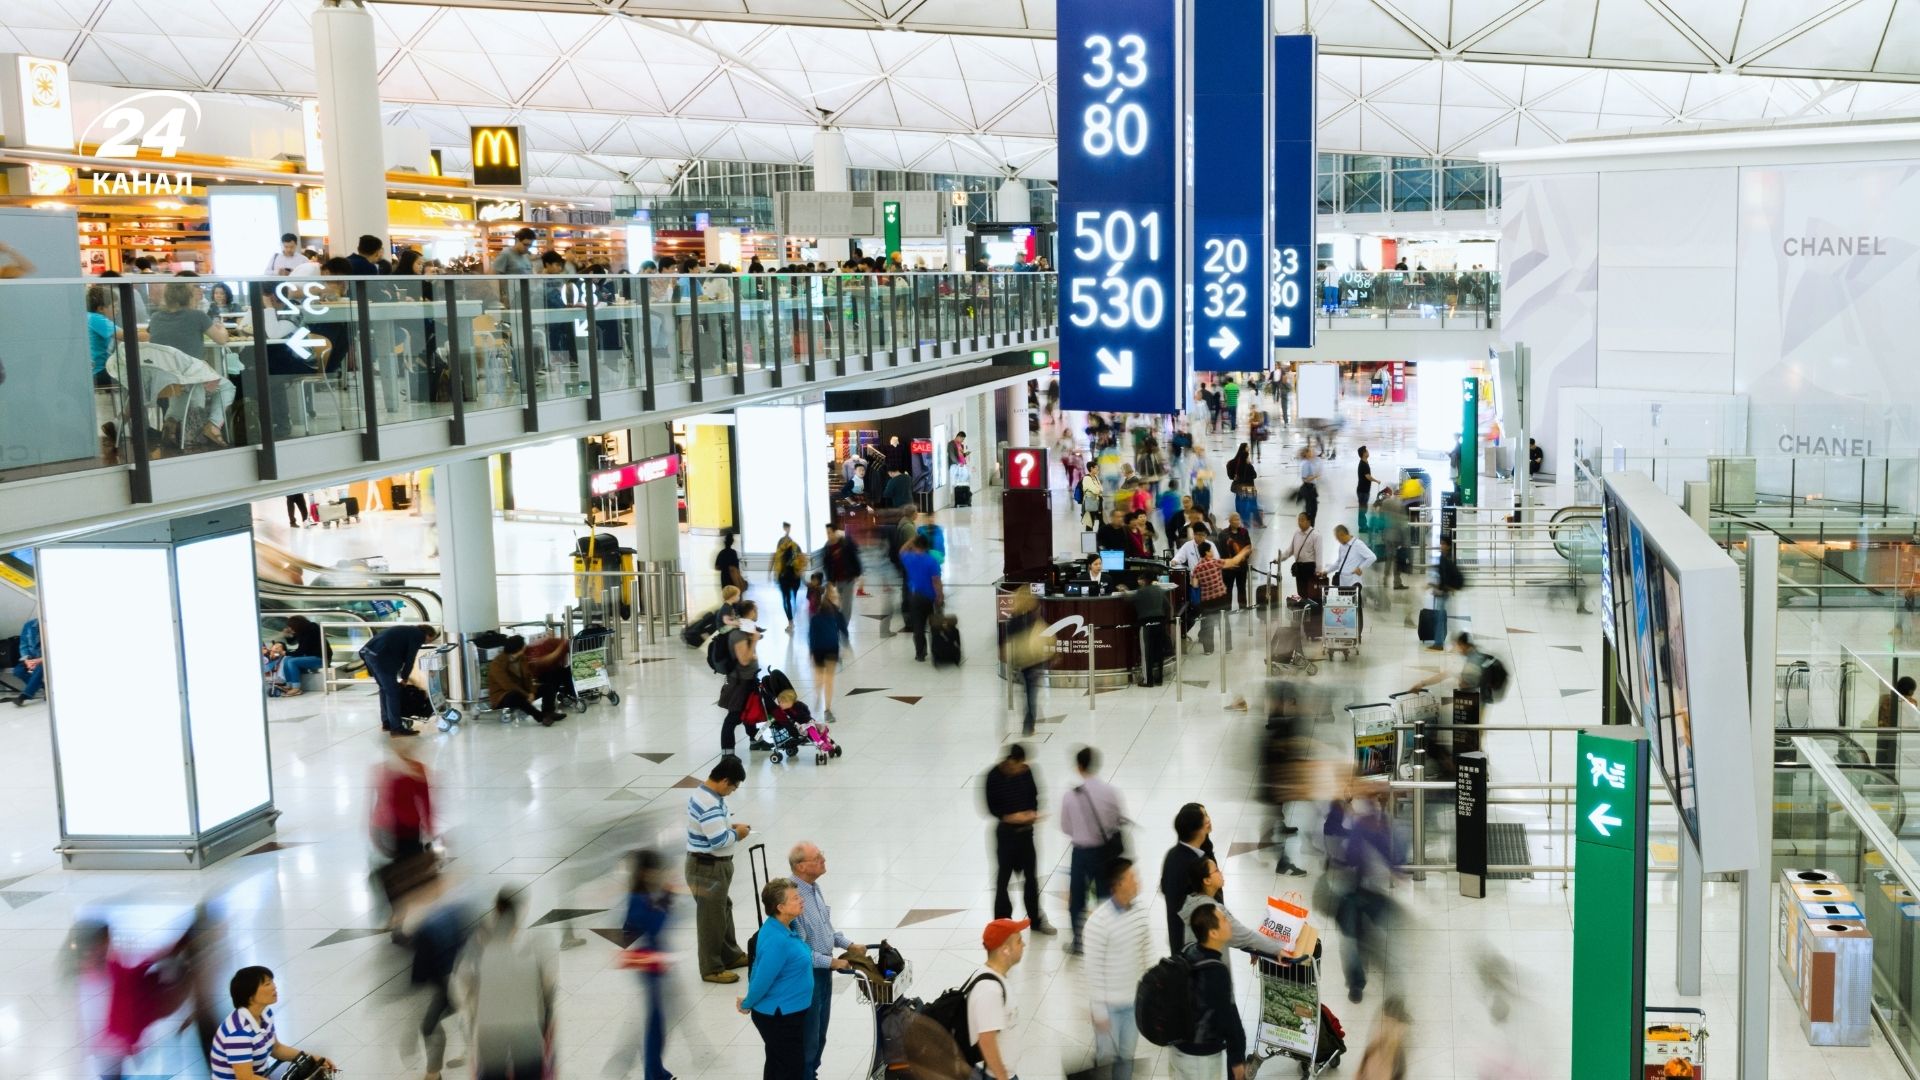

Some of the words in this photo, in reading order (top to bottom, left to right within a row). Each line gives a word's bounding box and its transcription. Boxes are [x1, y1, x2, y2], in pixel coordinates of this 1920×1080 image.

[1083, 35, 1148, 88] 33
[1083, 103, 1148, 156] 80
[1074, 211, 1160, 262] 501
[1783, 236, 1887, 257] CHANEL
[1204, 239, 1247, 273] 20
[1071, 277, 1163, 329] 530
[1204, 283, 1247, 318] 32
[912, 443, 932, 452] SALE
[1778, 434, 1878, 457] CHANEL
[1385, 734, 1394, 742] 40
